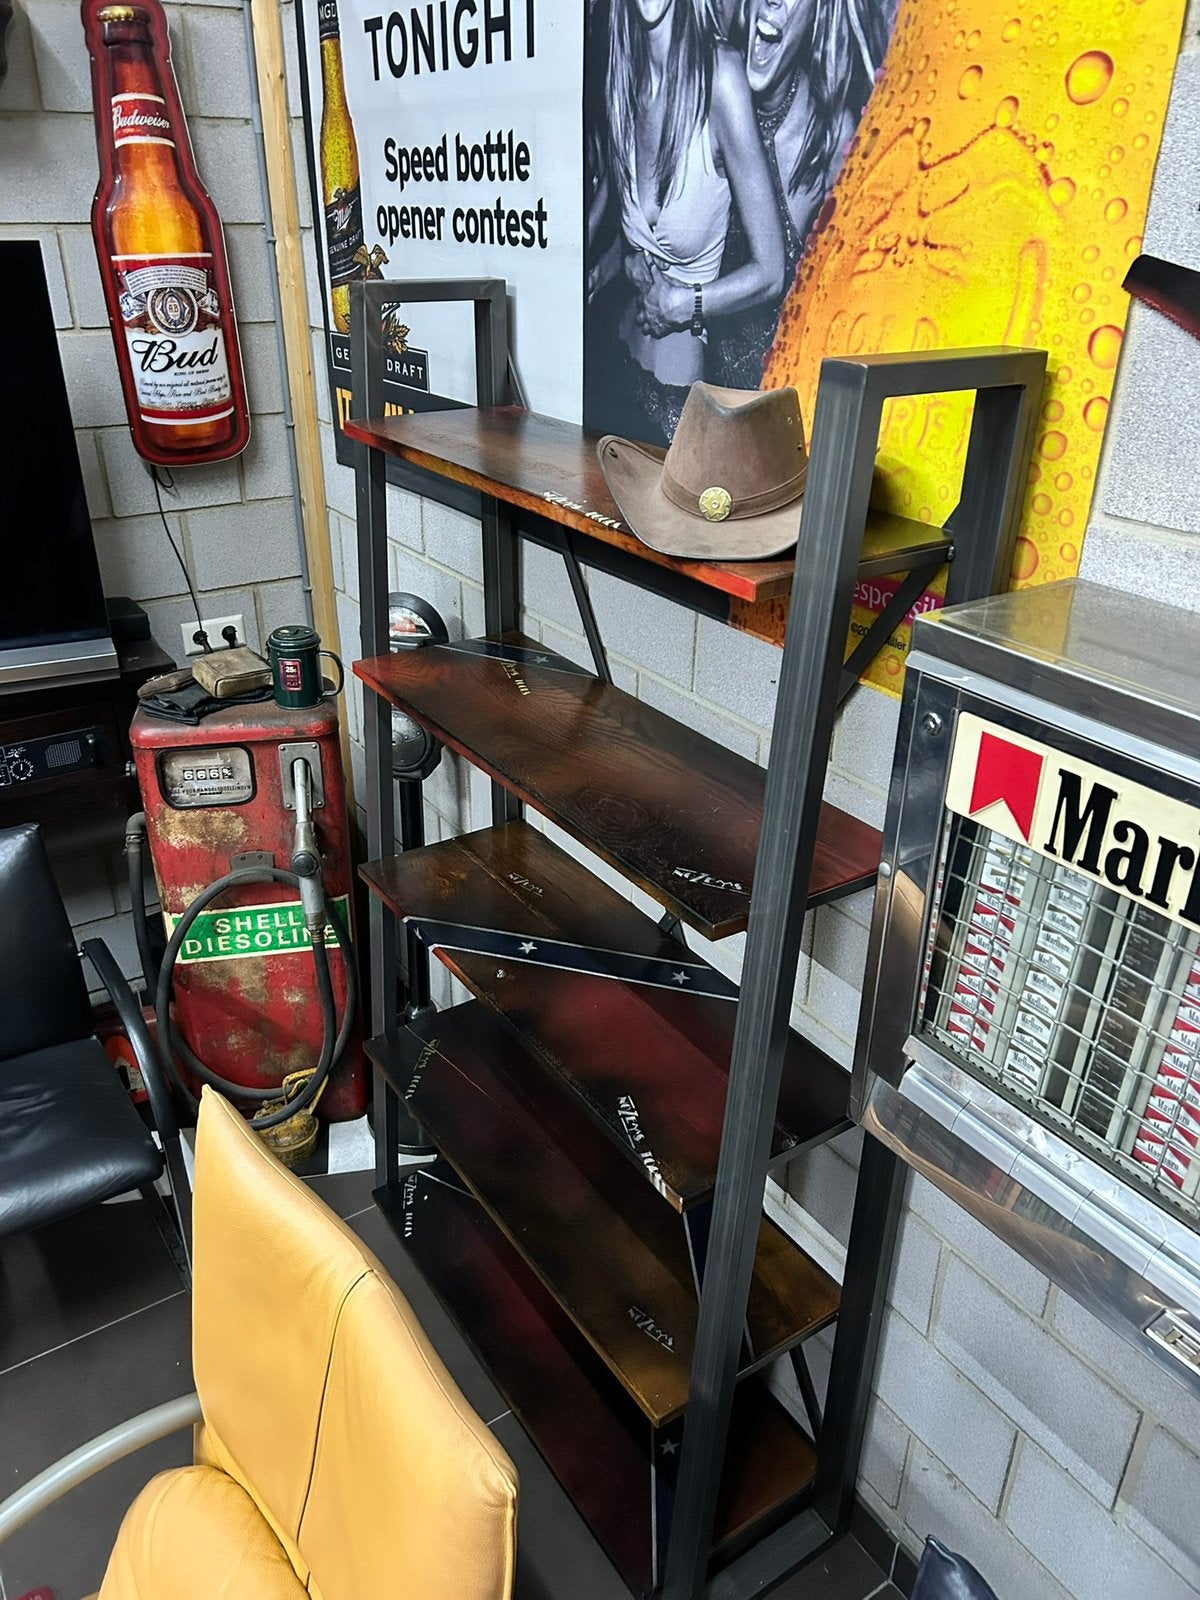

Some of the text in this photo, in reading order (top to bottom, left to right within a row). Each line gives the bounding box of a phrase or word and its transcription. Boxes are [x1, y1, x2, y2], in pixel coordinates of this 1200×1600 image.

[364, 0, 535, 81] TONIGHT
[112, 104, 170, 129] Budweiser
[384, 129, 531, 192] Speed bottle
[377, 196, 548, 249] opener contest
[131, 336, 218, 373] Bud
[386, 358, 423, 380] DRAFT
[215, 911, 302, 934] SHELL
